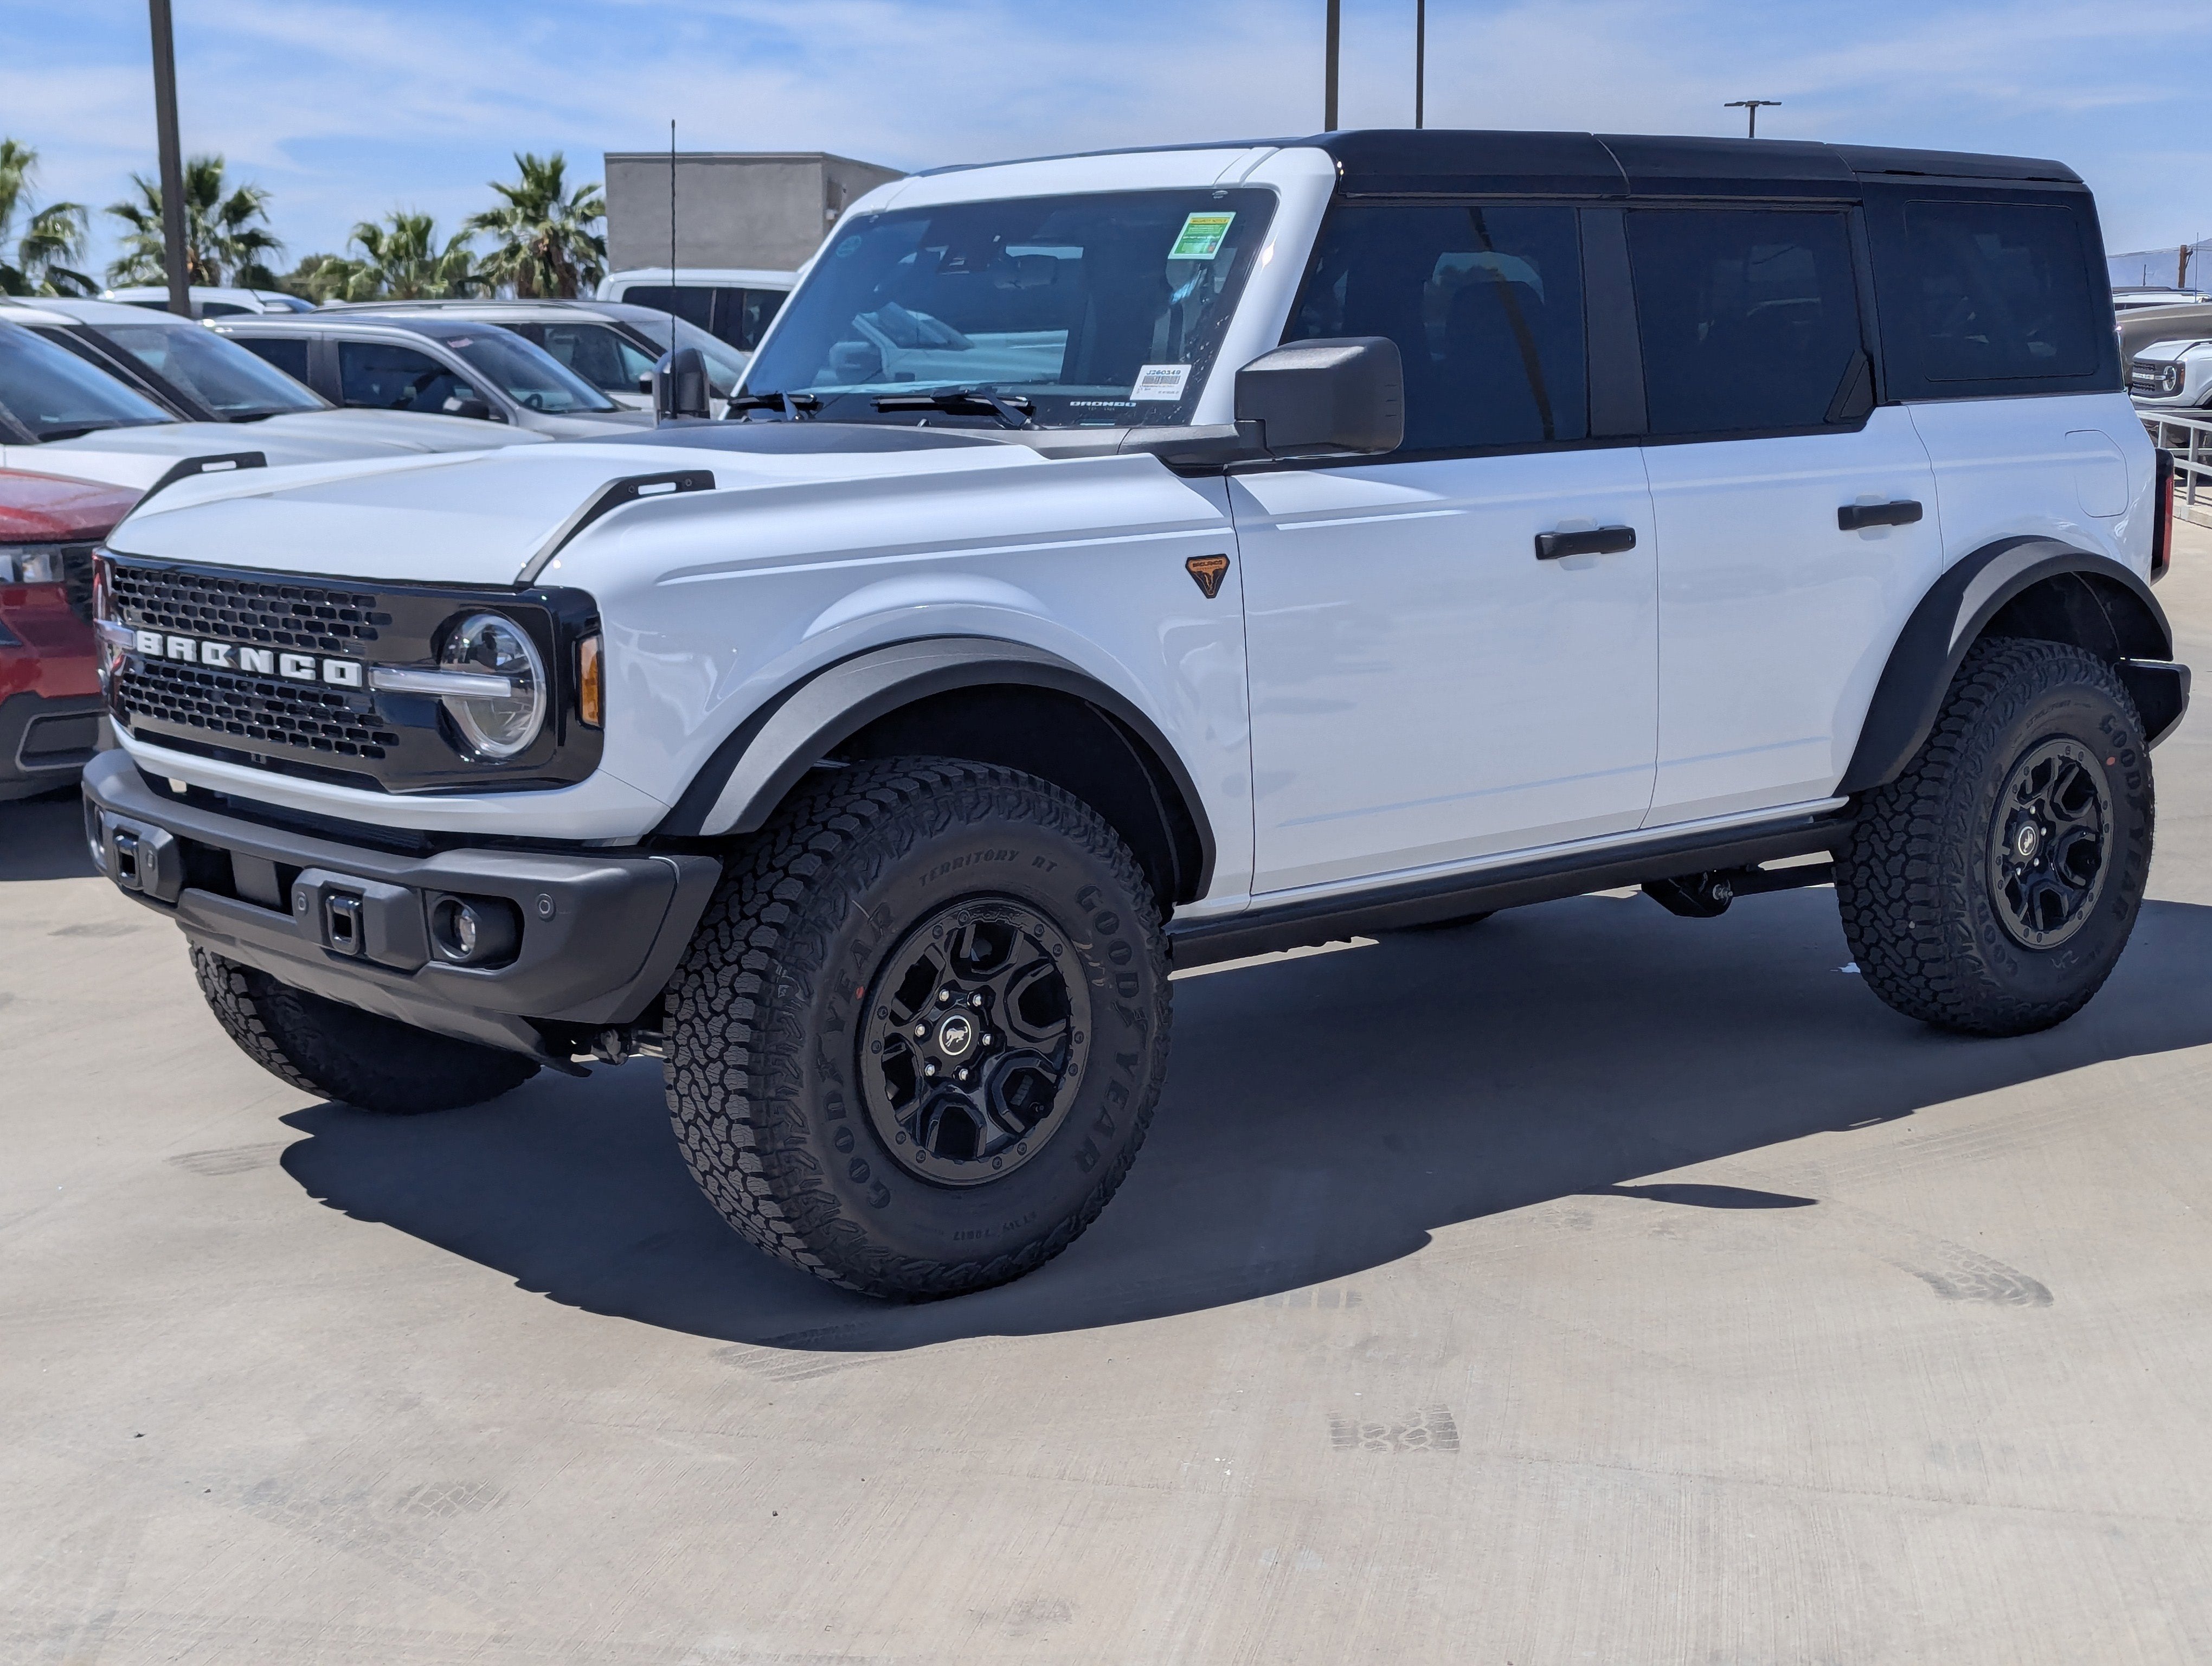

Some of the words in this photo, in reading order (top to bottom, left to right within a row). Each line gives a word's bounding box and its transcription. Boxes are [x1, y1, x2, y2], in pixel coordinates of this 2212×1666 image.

[136, 630, 363, 687] BRONCO
[919, 849, 1020, 887] TERRITORY
[1031, 855, 1057, 872] RT
[1073, 885, 1141, 1173] GOODYEAR
